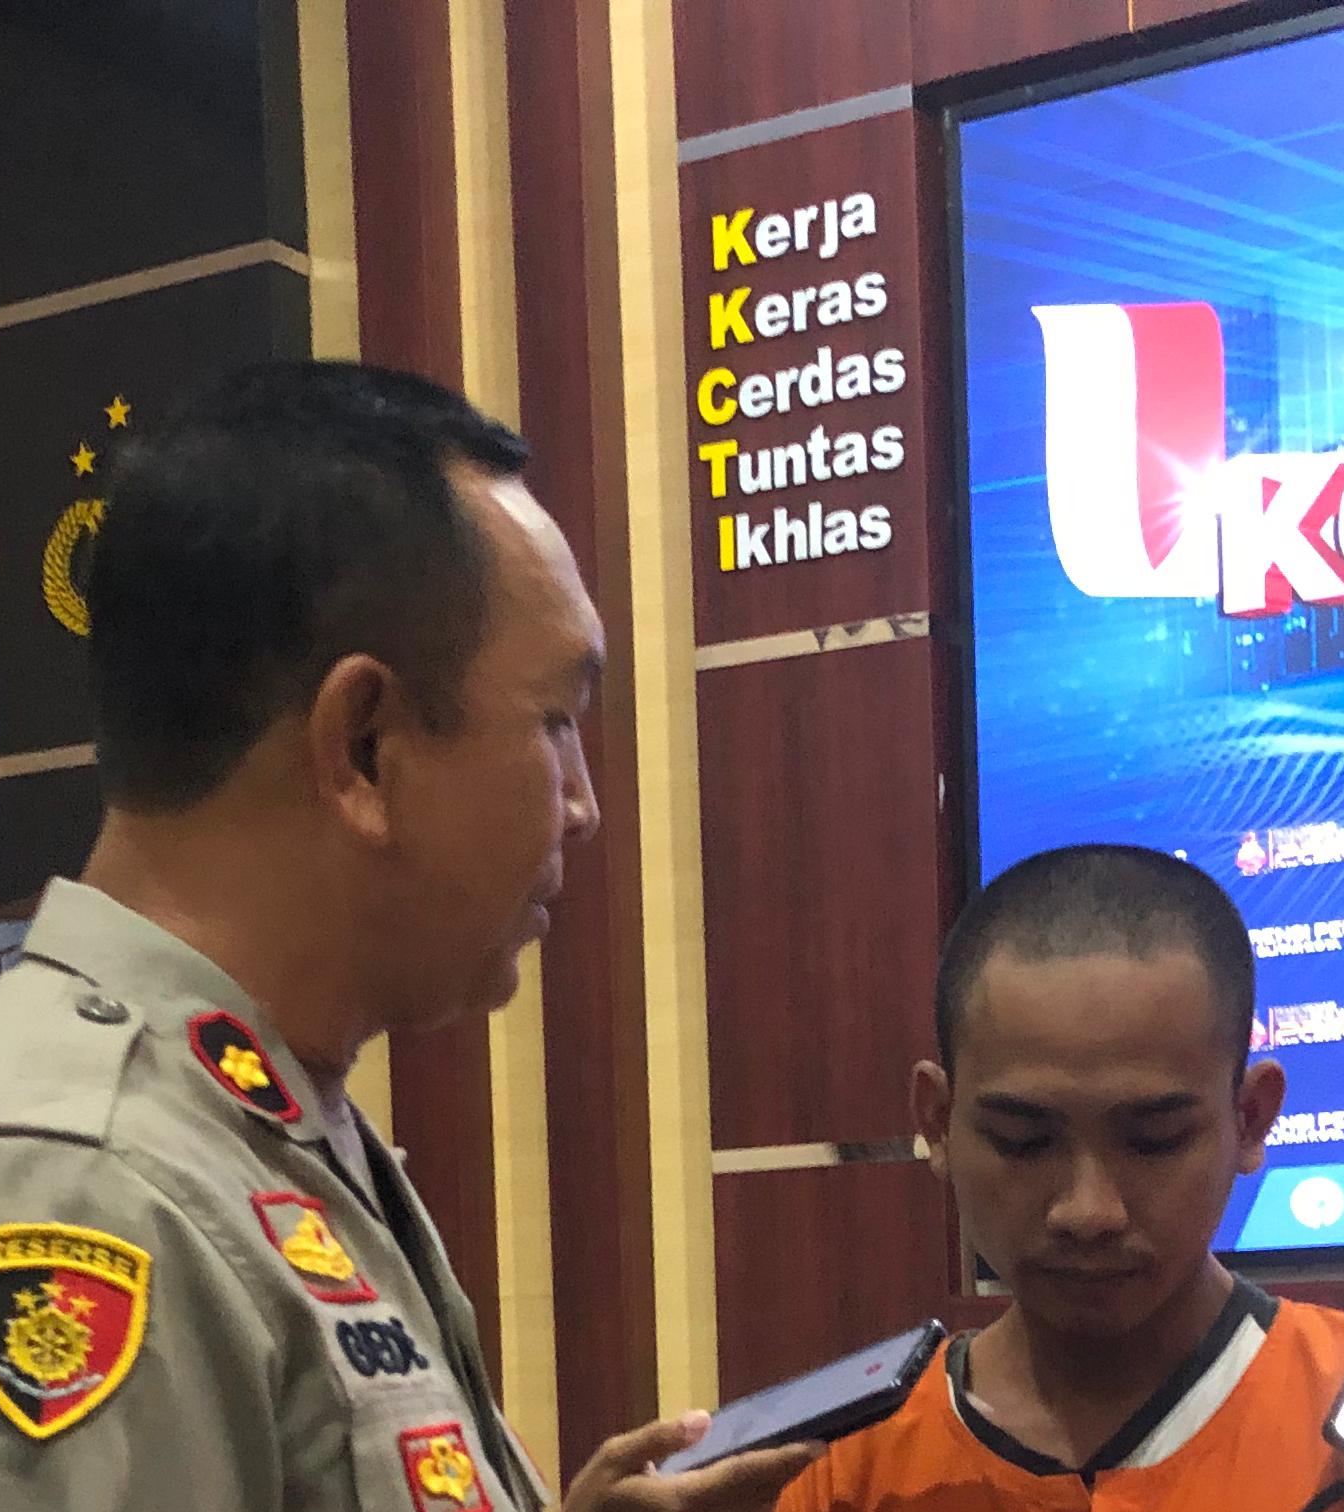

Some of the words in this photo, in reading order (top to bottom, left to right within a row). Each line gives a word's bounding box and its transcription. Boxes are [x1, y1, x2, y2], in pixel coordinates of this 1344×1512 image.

[711, 192, 877, 271] Kerja
[709, 271, 888, 350] Keras
[696, 345, 906, 427] Cerdas
[697, 424, 905, 499] Tuntas
[718, 501, 892, 572] Ikhlas
